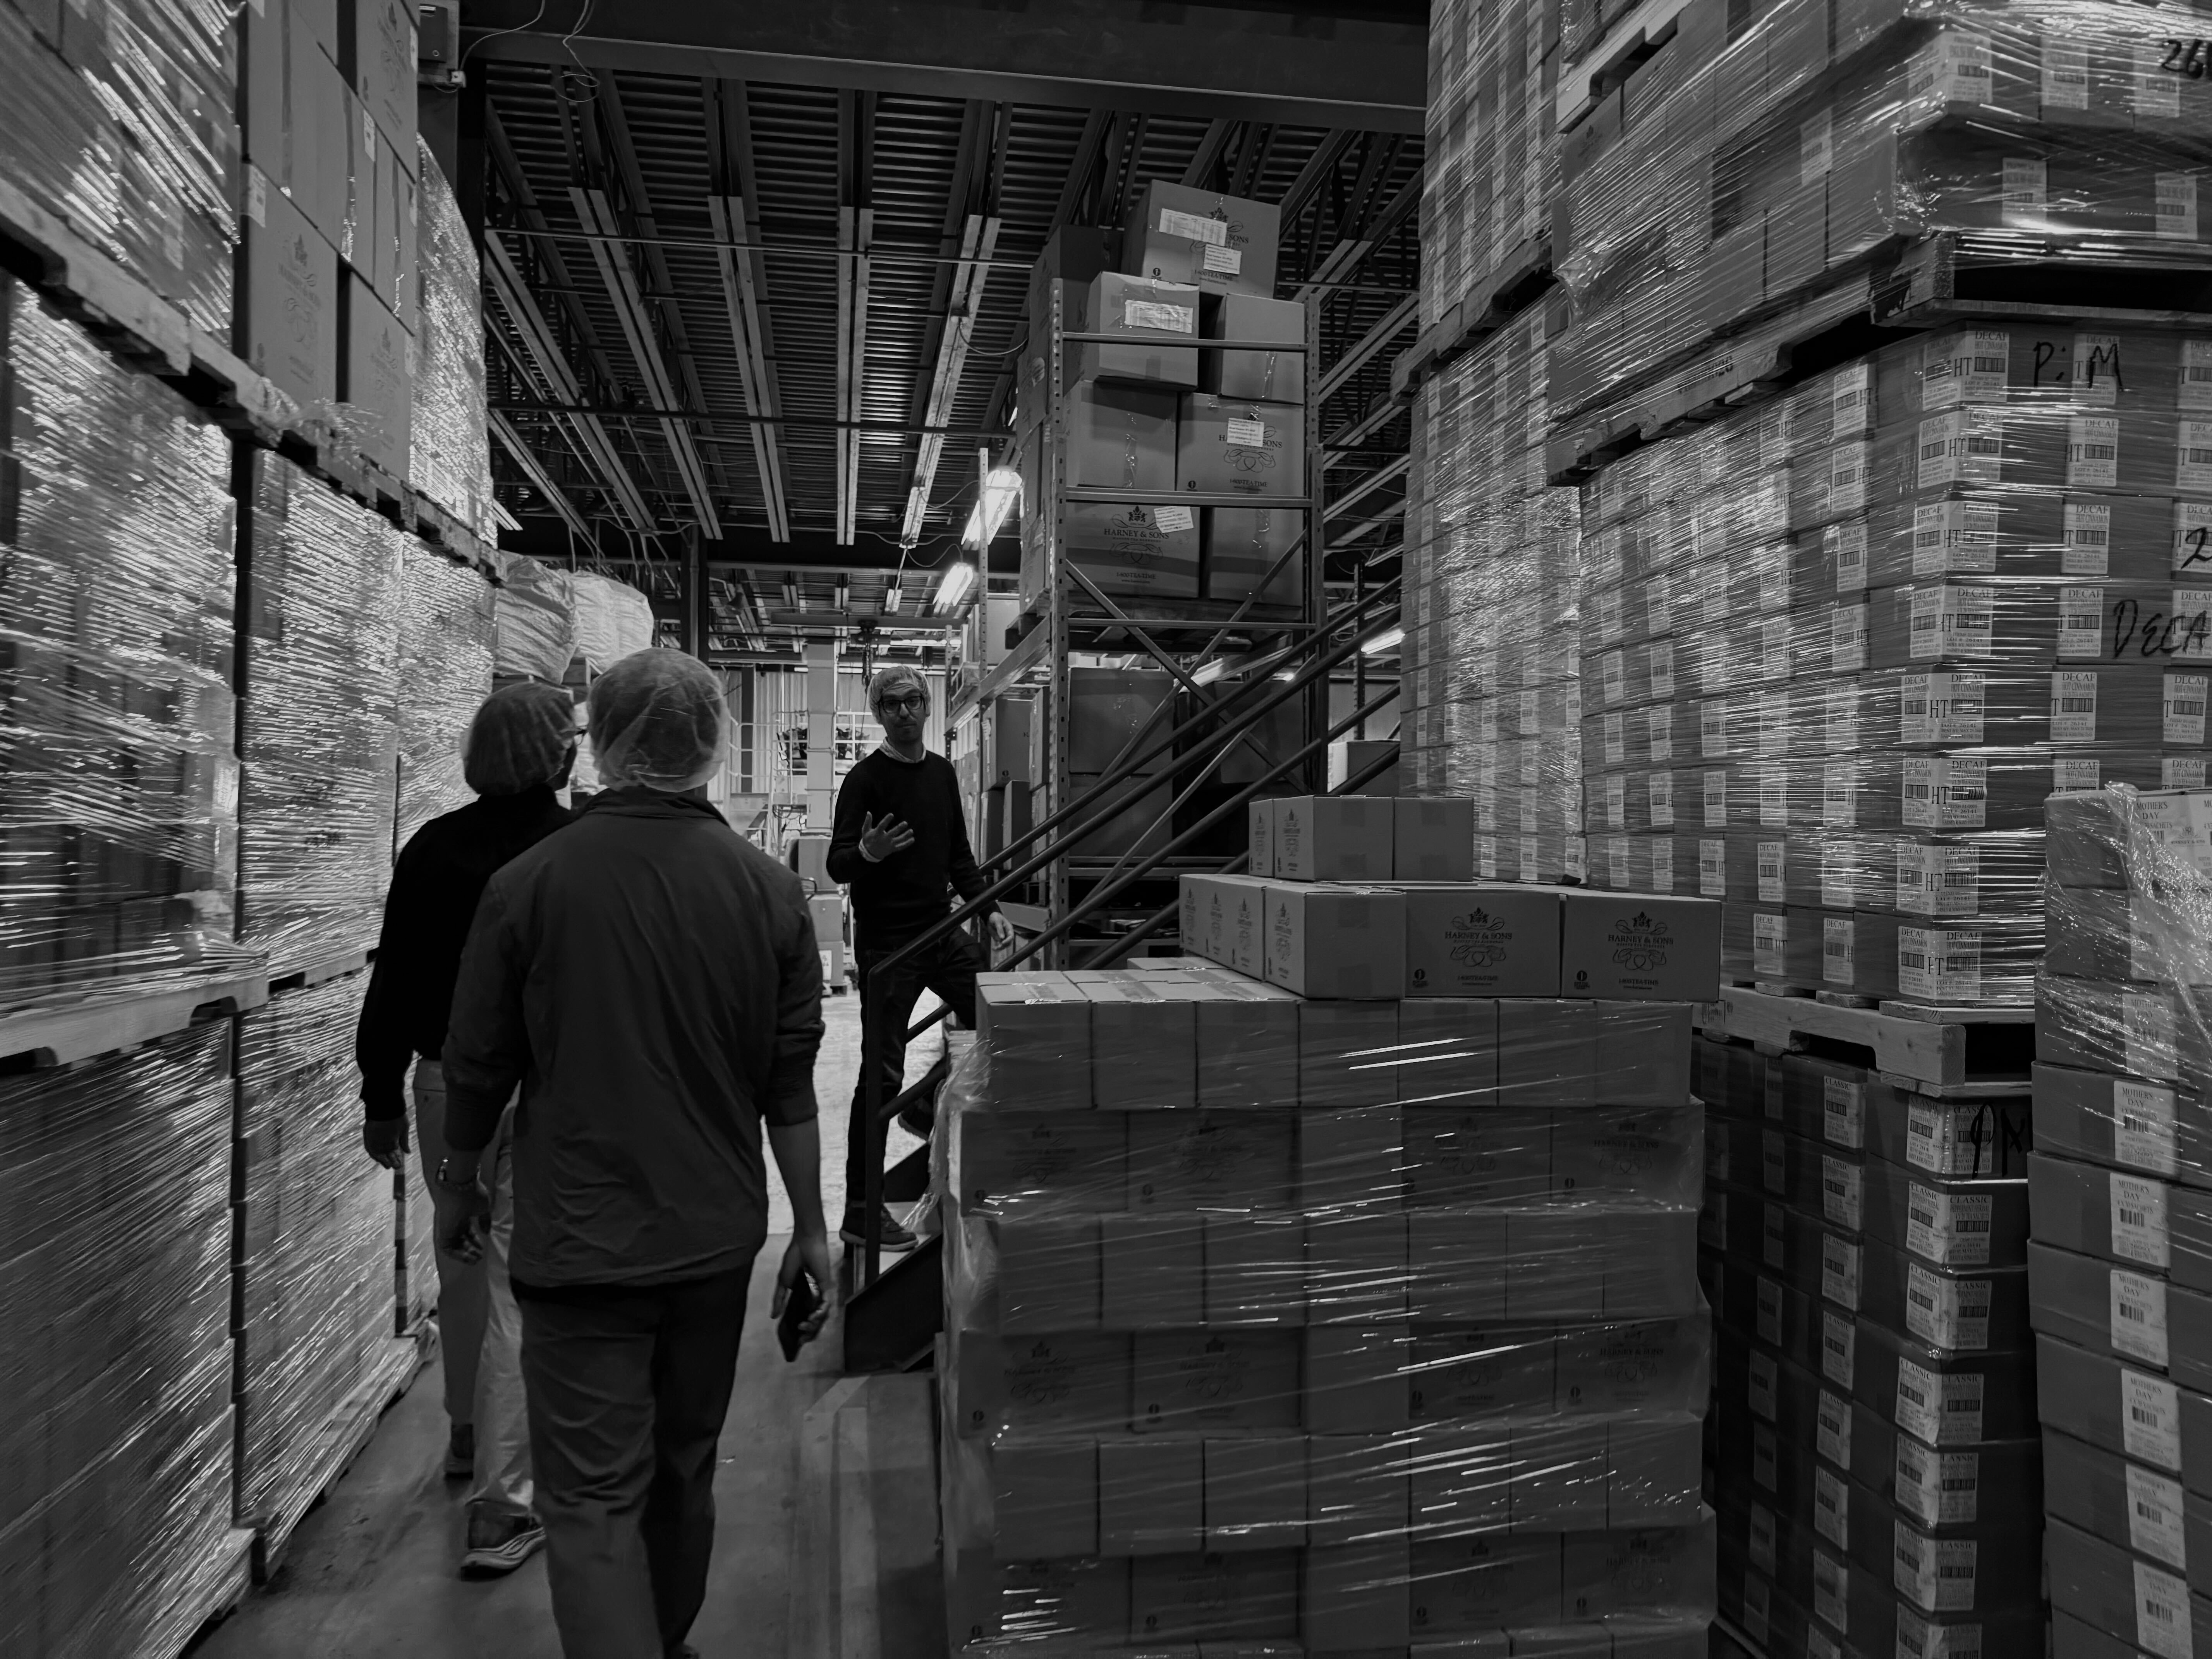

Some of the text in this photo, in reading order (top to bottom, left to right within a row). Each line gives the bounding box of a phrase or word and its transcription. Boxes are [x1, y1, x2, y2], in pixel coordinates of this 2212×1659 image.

[1954, 357, 1972, 377] HT
[1949, 438, 1965, 457] HT
[1918, 506, 1942, 517] DECAF
[2076, 505, 2108, 514] DECAF
[1104, 529, 1138, 537] HARNEY
[1944, 529, 1960, 548] HT
[1914, 590, 1937, 600] DECAF
[1958, 588, 1990, 597] DECAF
[1905, 675, 1929, 684] DECAF
[1952, 674, 1984, 683] DECAF
[2063, 673, 2095, 682] DECAF
[2175, 675, 2206, 685] DECAF
[1951, 684, 1984, 692] HOT CINNAMON
[1930, 700, 1948, 718] HT
[2066, 761, 2098, 769] DECAF
[2172, 760, 2204, 769] DECAF
[2172, 769, 2181, 778] HOT
[1932, 787, 1949, 804] HT
[2136, 801, 2168, 810] MOTHER'S
[1902, 847, 1923, 855] DECAF
[1826, 919, 1846, 929] DECAF
[1902, 928, 1925, 938] DECAF
[1947, 932, 1981, 940] DECAF
[1608, 934, 1642, 943] HARNEY
[1826, 1078, 1851, 1090] CLASSIC
[2122, 1087, 2153, 1099] MOTHER'S
[2128, 1098, 2143, 1107] DAY
[1825, 1157, 1849, 1170] CLASSIC
[1911, 1183, 1939, 1200] CLASSIC
[2119, 1180, 2149, 1194] MOTHER'S
[2124, 1191, 2139, 1200] DAY
[1911, 1266, 1941, 1283] CLASSIC
[2118, 1274, 2150, 1291] MOTHER'S
[2124, 1286, 2140, 1297] DAY
[1901, 1360, 1933, 1379] CLASSIC
